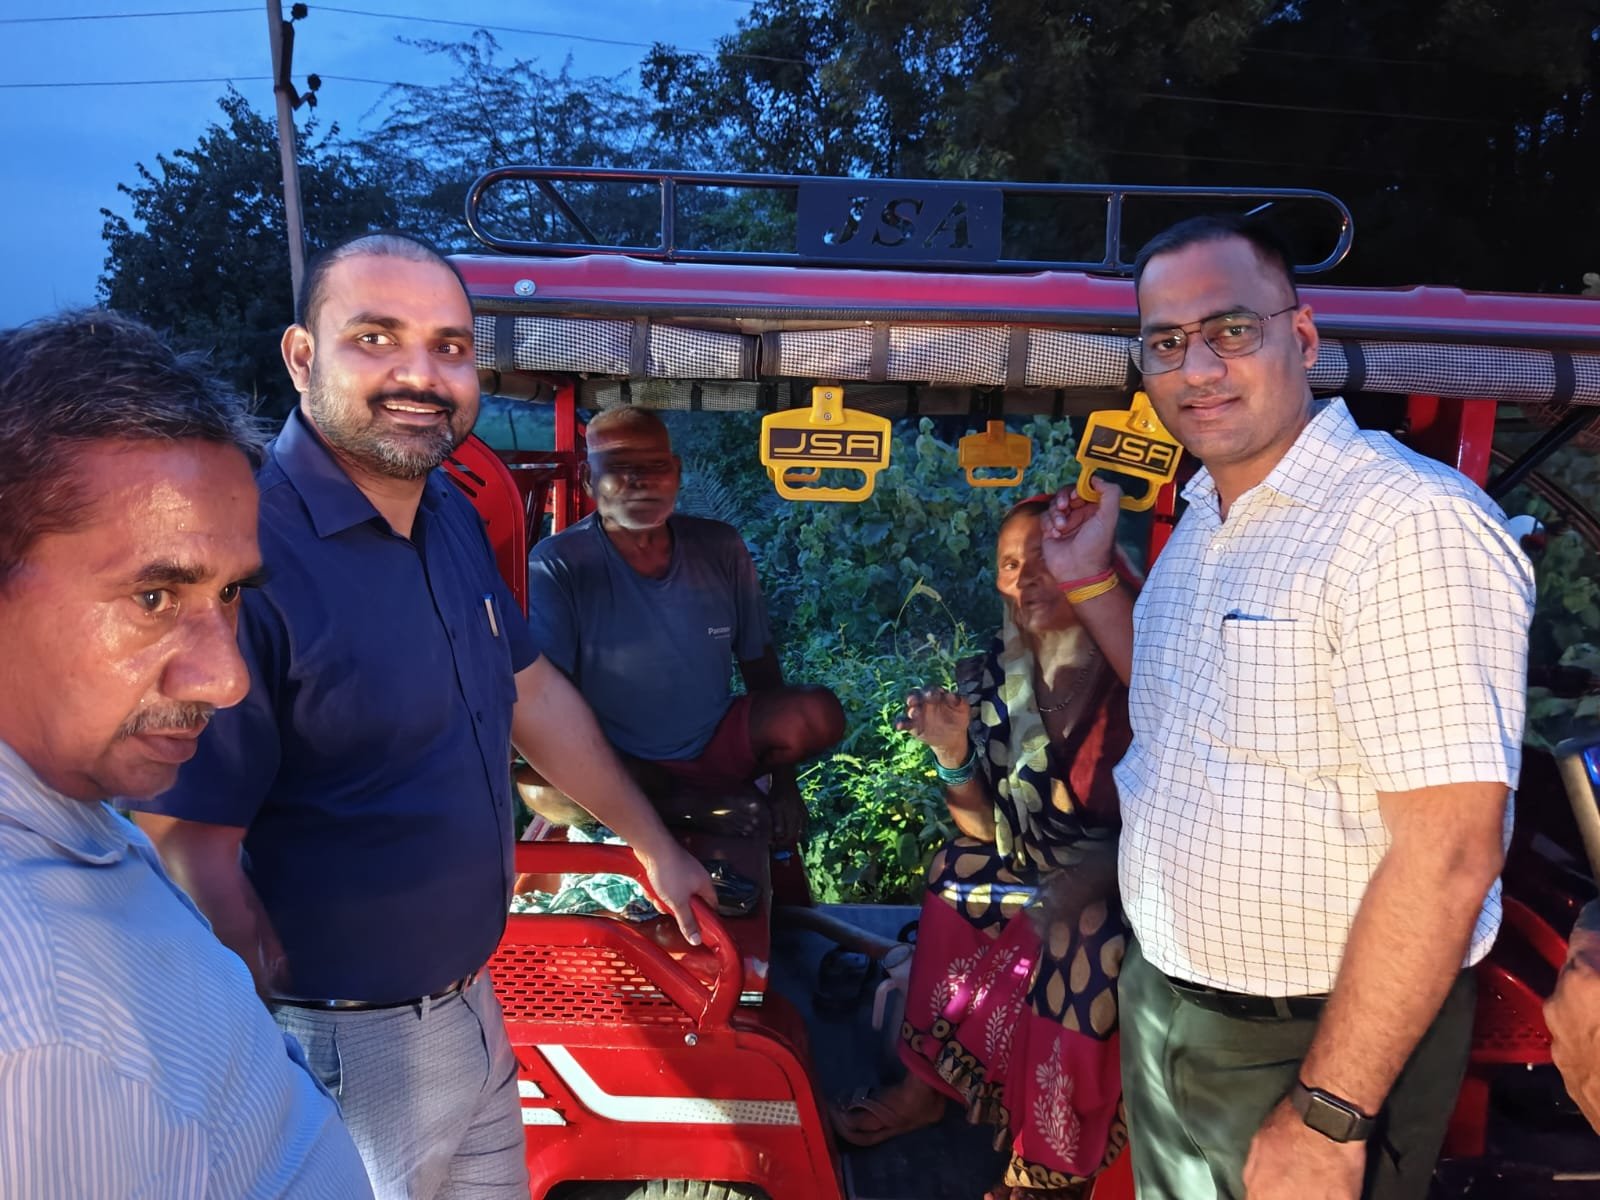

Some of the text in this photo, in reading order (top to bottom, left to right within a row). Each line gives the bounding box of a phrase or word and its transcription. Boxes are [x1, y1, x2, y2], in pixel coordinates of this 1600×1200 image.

[823, 197, 972, 249] JSA
[773, 432, 880, 456] JSA
[1091, 434, 1174, 468] JSA
